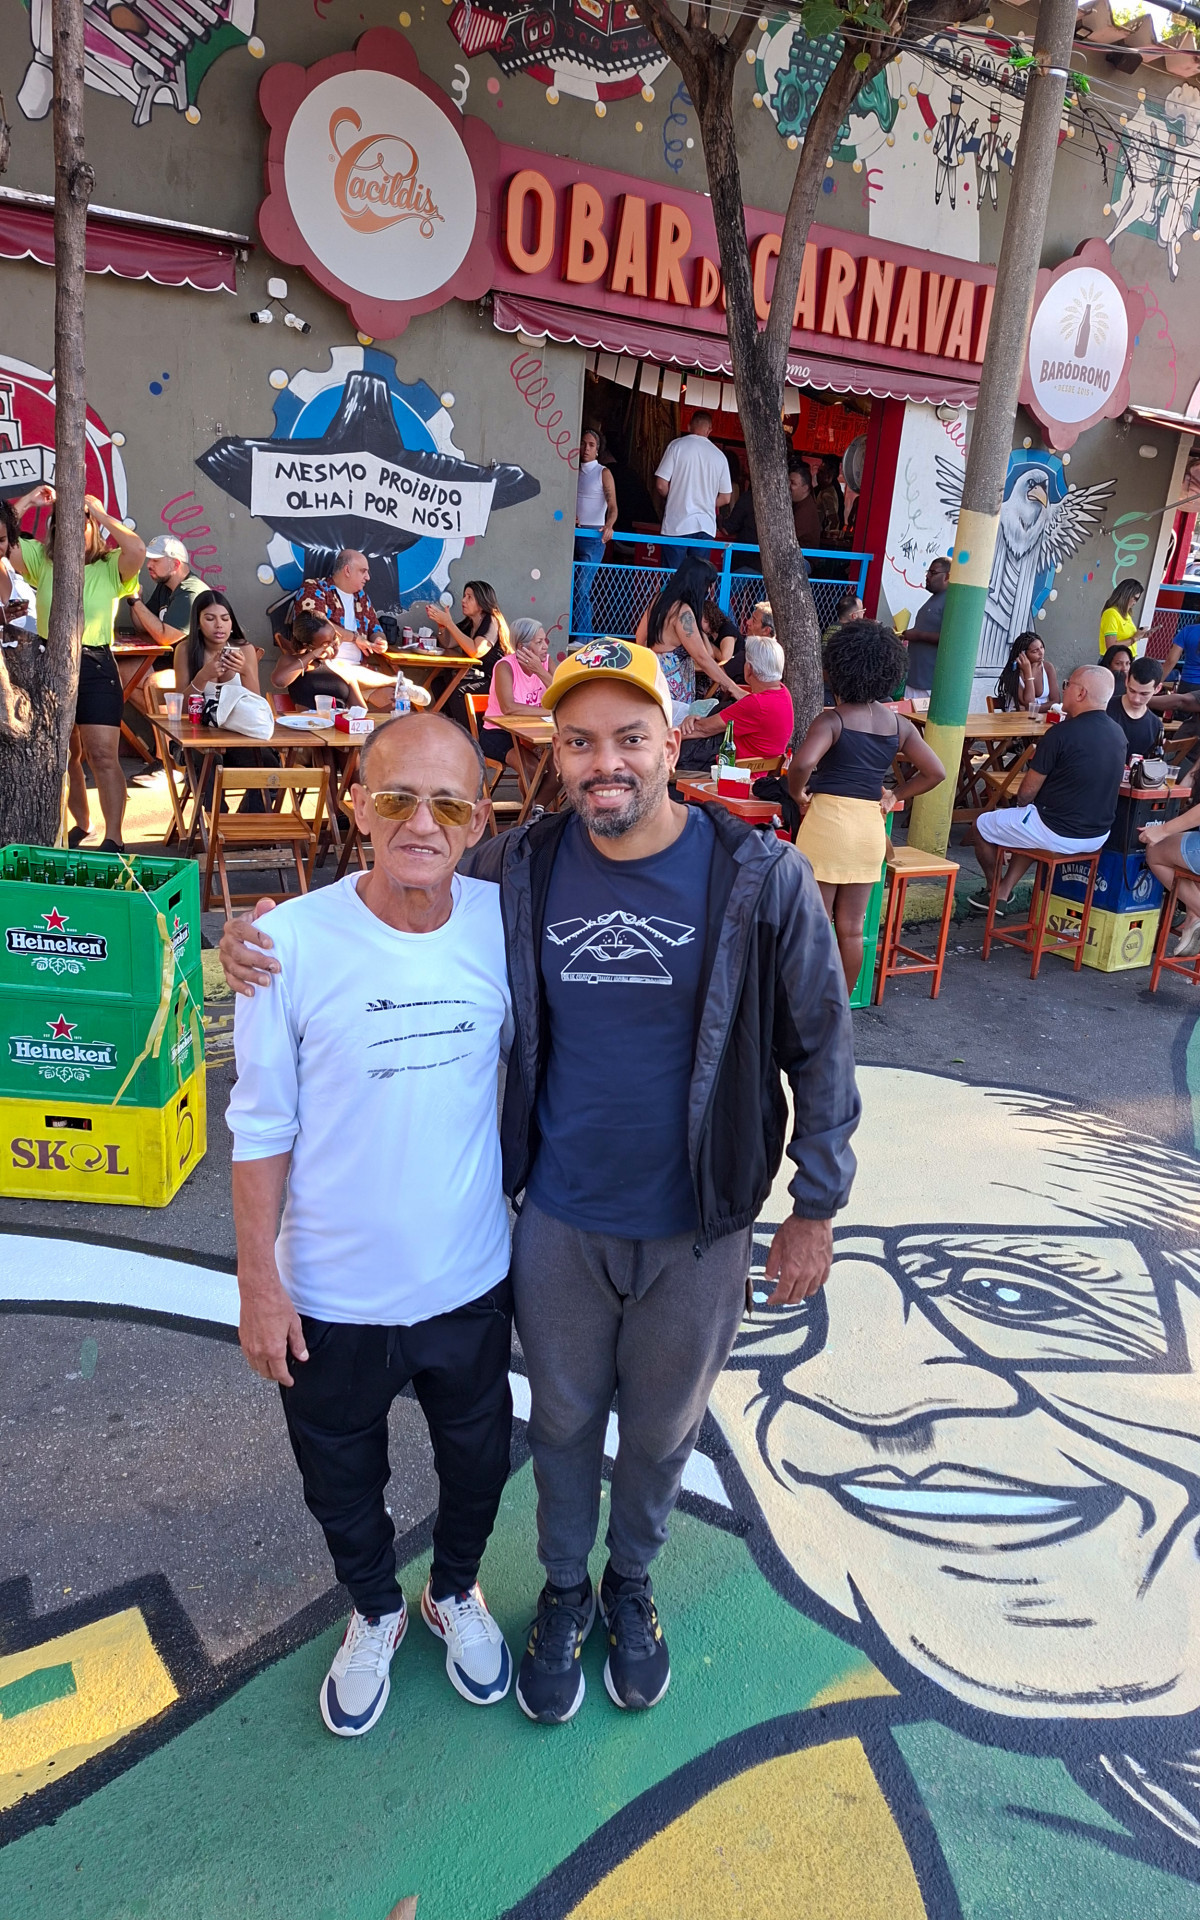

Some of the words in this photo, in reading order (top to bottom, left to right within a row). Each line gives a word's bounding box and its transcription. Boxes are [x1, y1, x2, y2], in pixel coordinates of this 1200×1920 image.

[328, 106, 445, 239] Cacildis
[502, 169, 556, 274] O
[561, 182, 692, 306] BAR
[693, 256, 726, 313] D
[1039, 359, 1111, 393] BARÓDROMO
[275, 461, 367, 483] MESMO
[364, 492, 398, 519] POR
[411, 507, 462, 532] NÓS!
[350, 721, 361, 732] 42
[10, 932, 103, 956] Heineken
[15, 1041, 111, 1063] Heineken
[10, 1137, 129, 1176] SKOL
